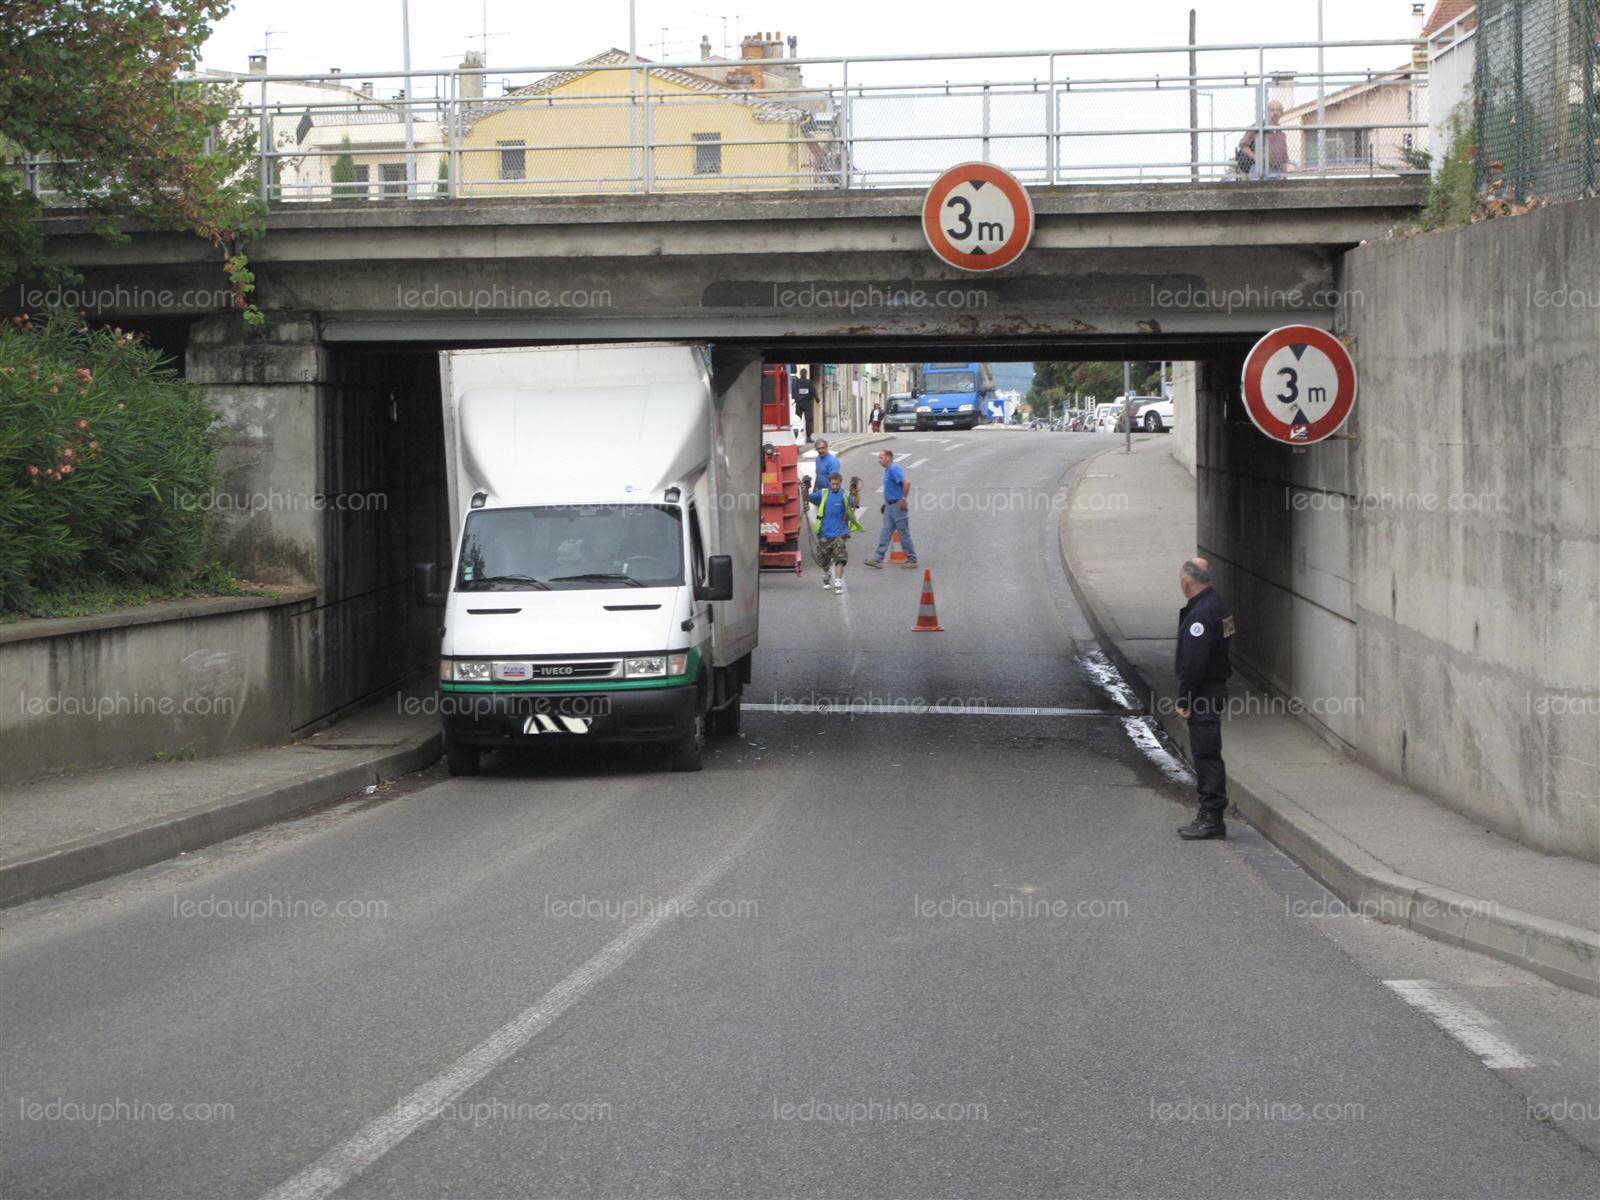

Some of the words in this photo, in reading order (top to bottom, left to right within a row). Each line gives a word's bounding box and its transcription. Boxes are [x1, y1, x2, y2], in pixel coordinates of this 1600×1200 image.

[947, 196, 973, 240] 3
[978, 221, 1004, 241] m
[1276, 367, 1299, 404] 3
[1308, 387, 1326, 402] m
[541, 667, 573, 675] IVECO
